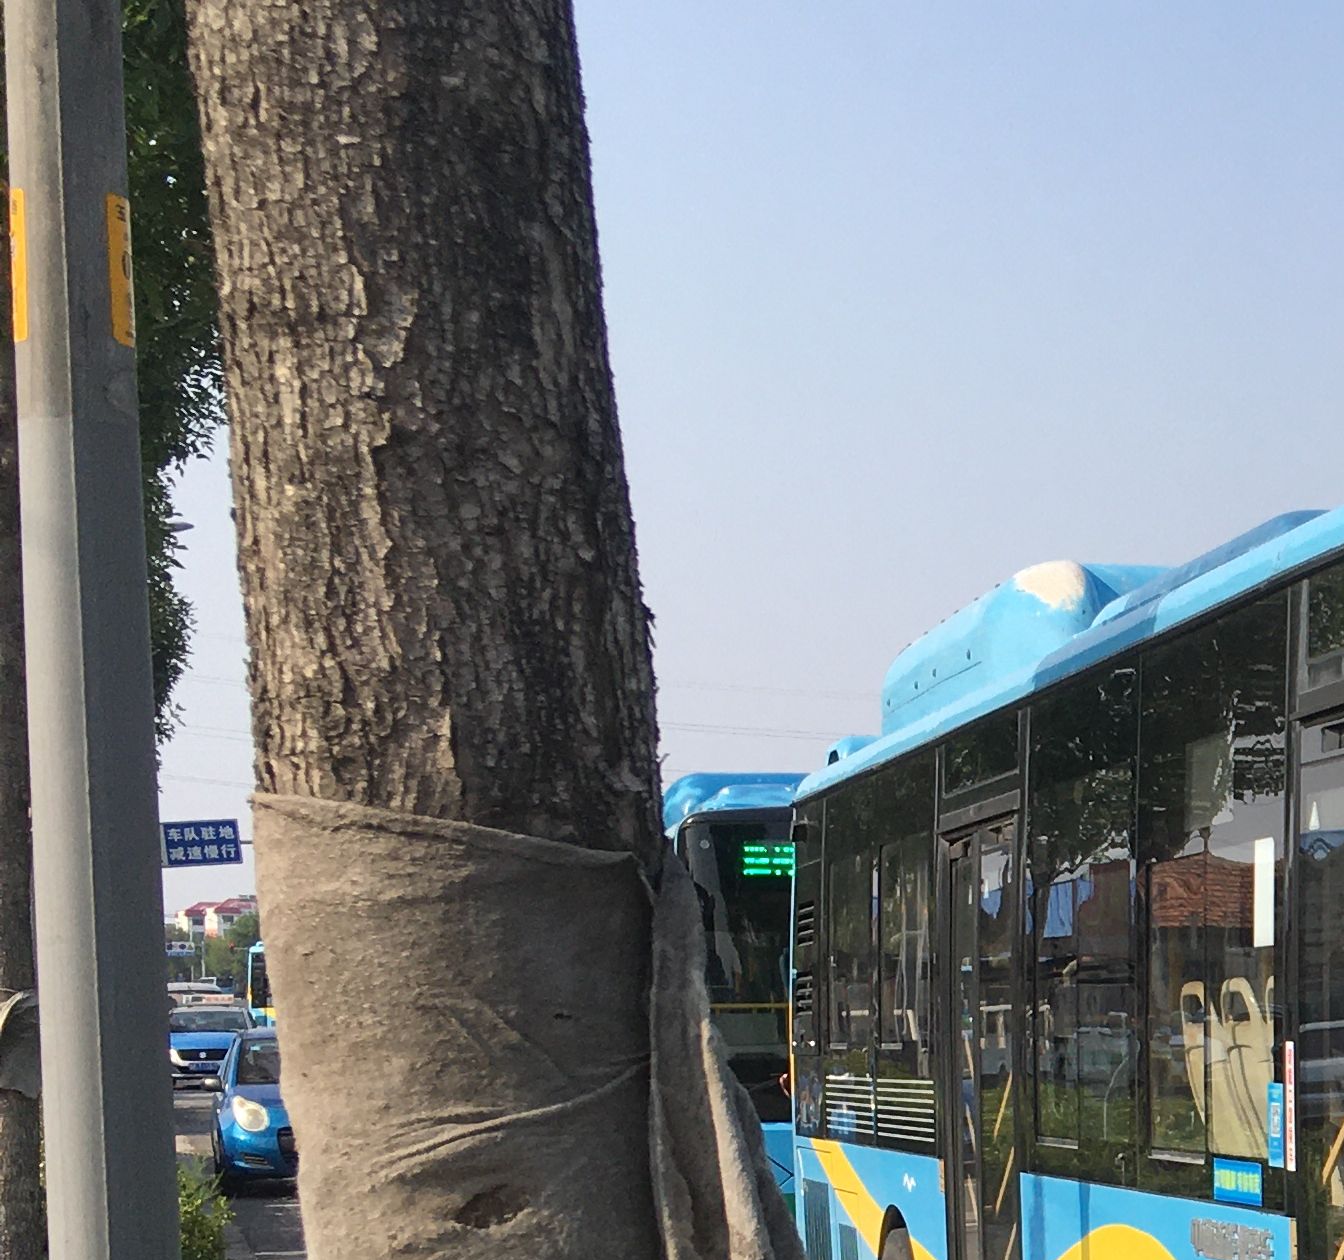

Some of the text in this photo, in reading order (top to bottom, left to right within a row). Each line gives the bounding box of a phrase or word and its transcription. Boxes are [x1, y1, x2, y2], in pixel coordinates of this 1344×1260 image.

[167, 825, 235, 841] 车队驻地
[169, 844, 236, 860] 减速慢行
